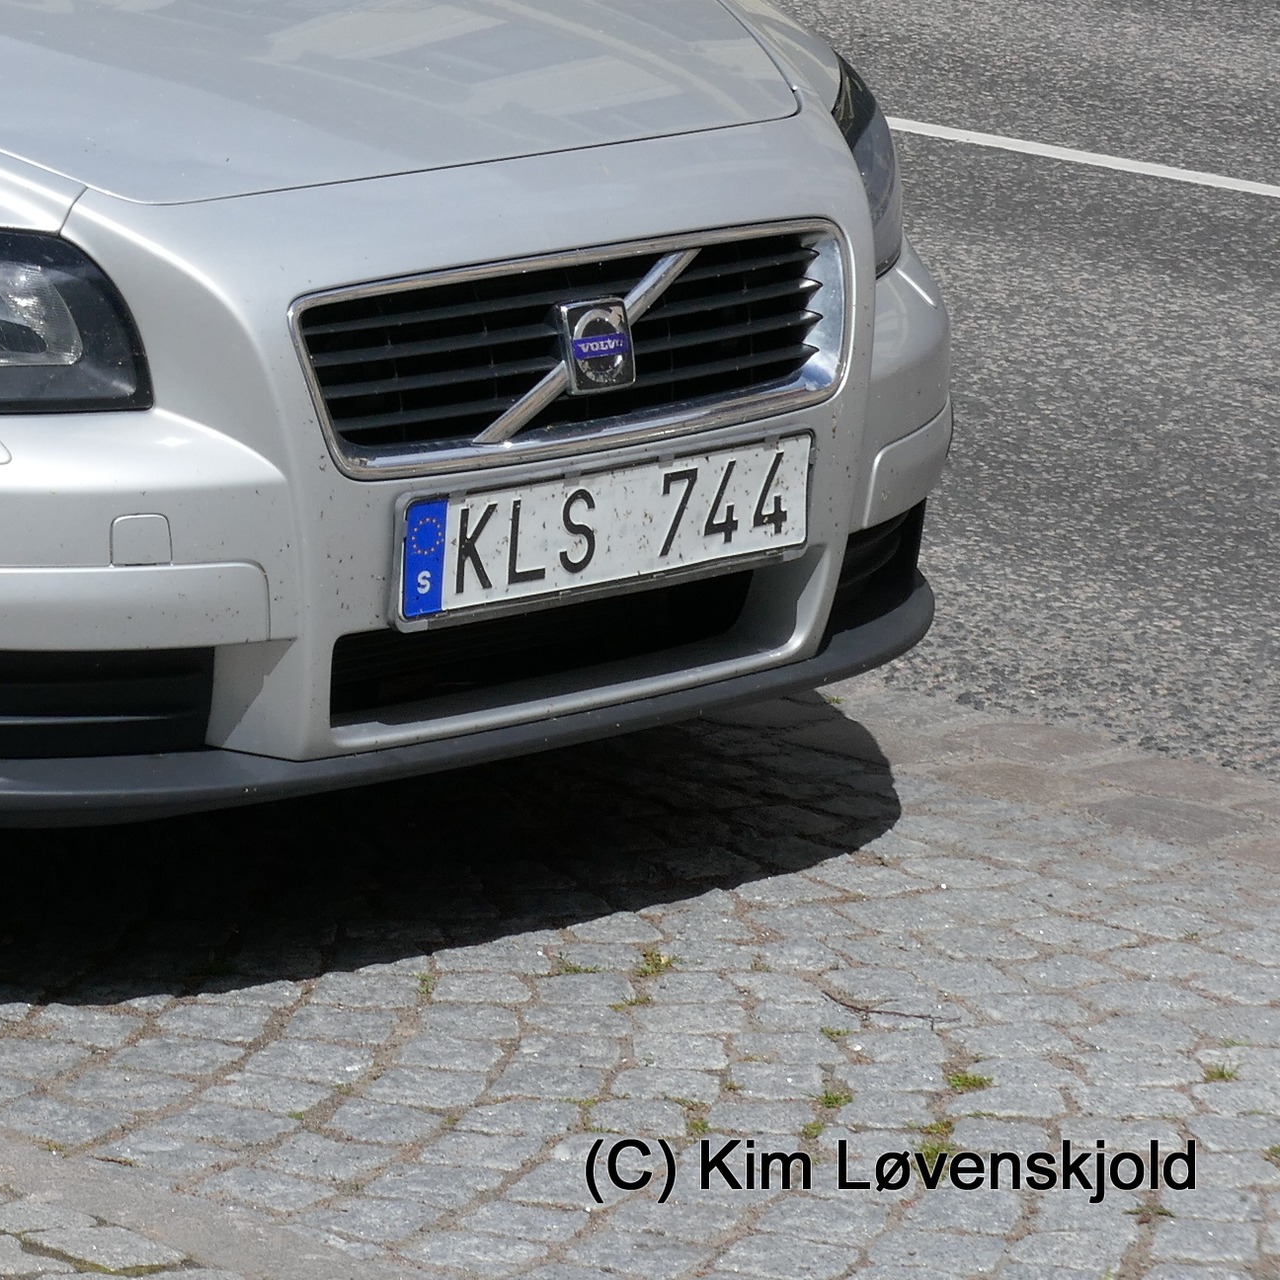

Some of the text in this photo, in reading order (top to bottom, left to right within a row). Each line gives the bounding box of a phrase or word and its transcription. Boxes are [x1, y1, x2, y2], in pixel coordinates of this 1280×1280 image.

[455, 451, 788, 595] KLS 744
[416, 571, 431, 595] S
